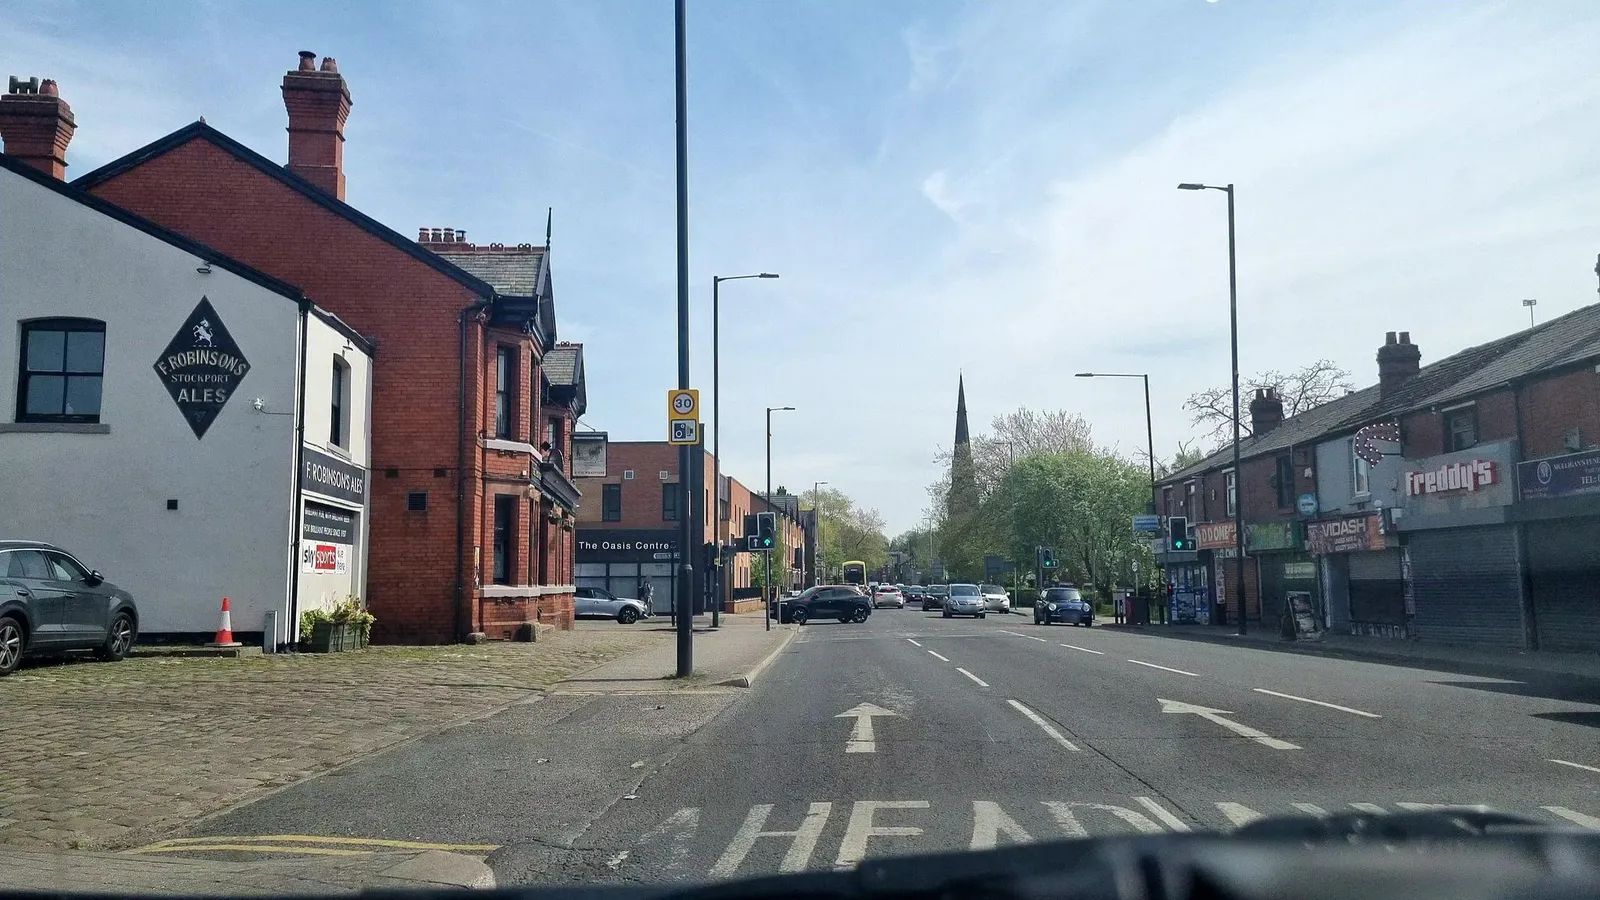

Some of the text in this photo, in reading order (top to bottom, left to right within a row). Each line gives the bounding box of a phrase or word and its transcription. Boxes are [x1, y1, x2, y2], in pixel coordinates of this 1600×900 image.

[171, 374, 230, 383] STOCKPORT
[177, 388, 227, 403] ALES
[675, 398, 692, 408] 30
[312, 463, 350, 491] ROBINSON'S
[350, 476, 363, 494] ALES
[1320, 518, 1366, 537] VIDASH
[578, 541, 669, 550] The Oasis Centre
[303, 545, 316, 568] sky
[316, 549, 336, 568] sports
